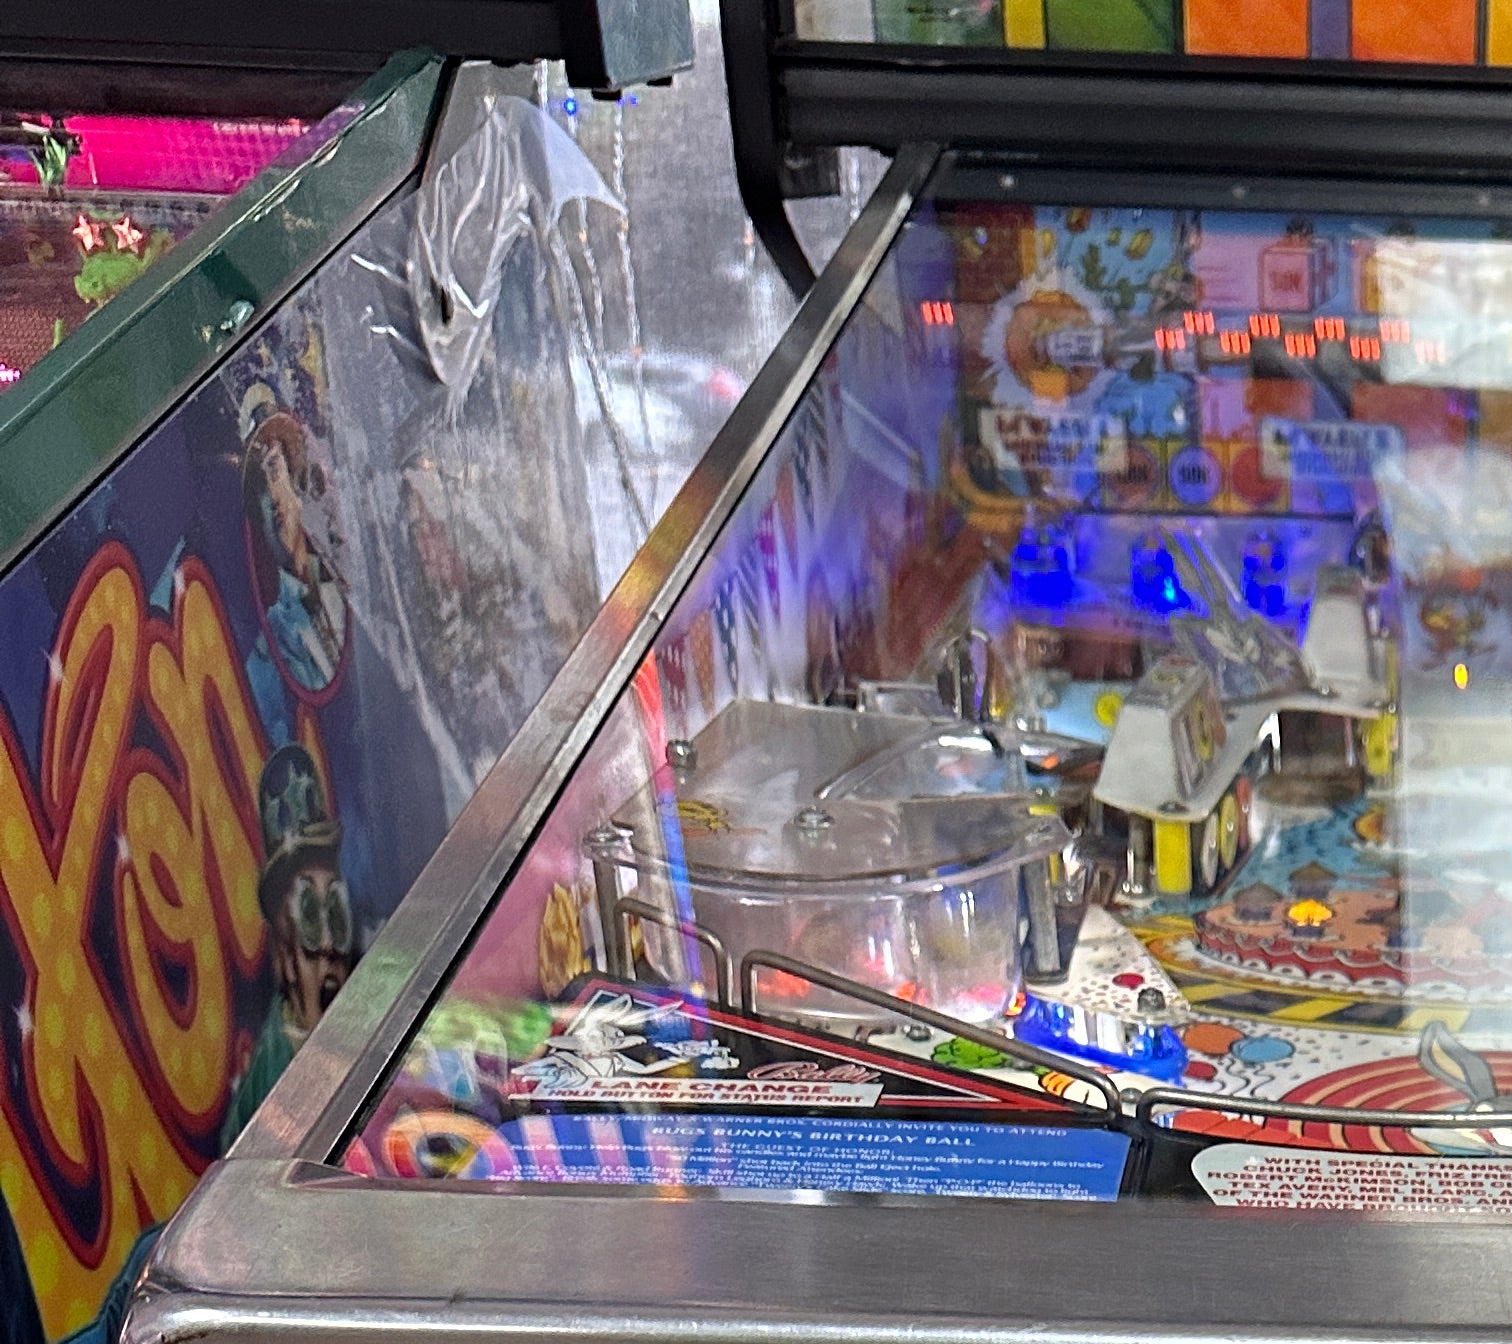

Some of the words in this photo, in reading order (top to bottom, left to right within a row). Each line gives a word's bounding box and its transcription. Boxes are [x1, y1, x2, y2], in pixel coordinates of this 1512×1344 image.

[747, 1060, 882, 1085] Bally
[592, 1080, 682, 1091] LANE
[690, 1082, 833, 1095] CHANGE
[548, 1089, 595, 1098] HOLD
[600, 1090, 674, 1099] BUTTON
[679, 1091, 714, 1100] FOR
[720, 1092, 787, 1102] STATUS
[792, 1093, 864, 1104] REPORT
[811, 1119, 893, 1130] CORDIALLY
[898, 1122, 944, 1131] INVITE
[948, 1124, 980, 1133] YOU
[984, 1126, 1005, 1134] TO
[1008, 1127, 1068, 1137] ATTEND
[651, 1127, 706, 1136] BUGS
[713, 1128, 804, 1140] BUNNY'S
[810, 1133, 918, 1146] BIRTHDAY
[924, 1136, 977, 1147] BALL
[1264, 1157, 1321, 1166] WITH
[1328, 1159, 1420, 1169] SPECIAL
[1207, 1171, 1299, 1181] ROBERT
[1438, 1179, 1484, 1188] BOB
[1243, 1165, 1322, 1175] CHUCK
[1415, 1171, 1465, 1180] FRIZ
[1213, 1188, 1243, 1197] OF
[1249, 1190, 1294, 1199] THE
[1300, 1192, 1396, 1203] WARNER
[1229, 1181, 1271, 1189] TEX
[1359, 1186, 1404, 1195] MEL
[1236, 1198, 1289, 1208] WHO
[1296, 1201, 1357, 1210] HAVE
